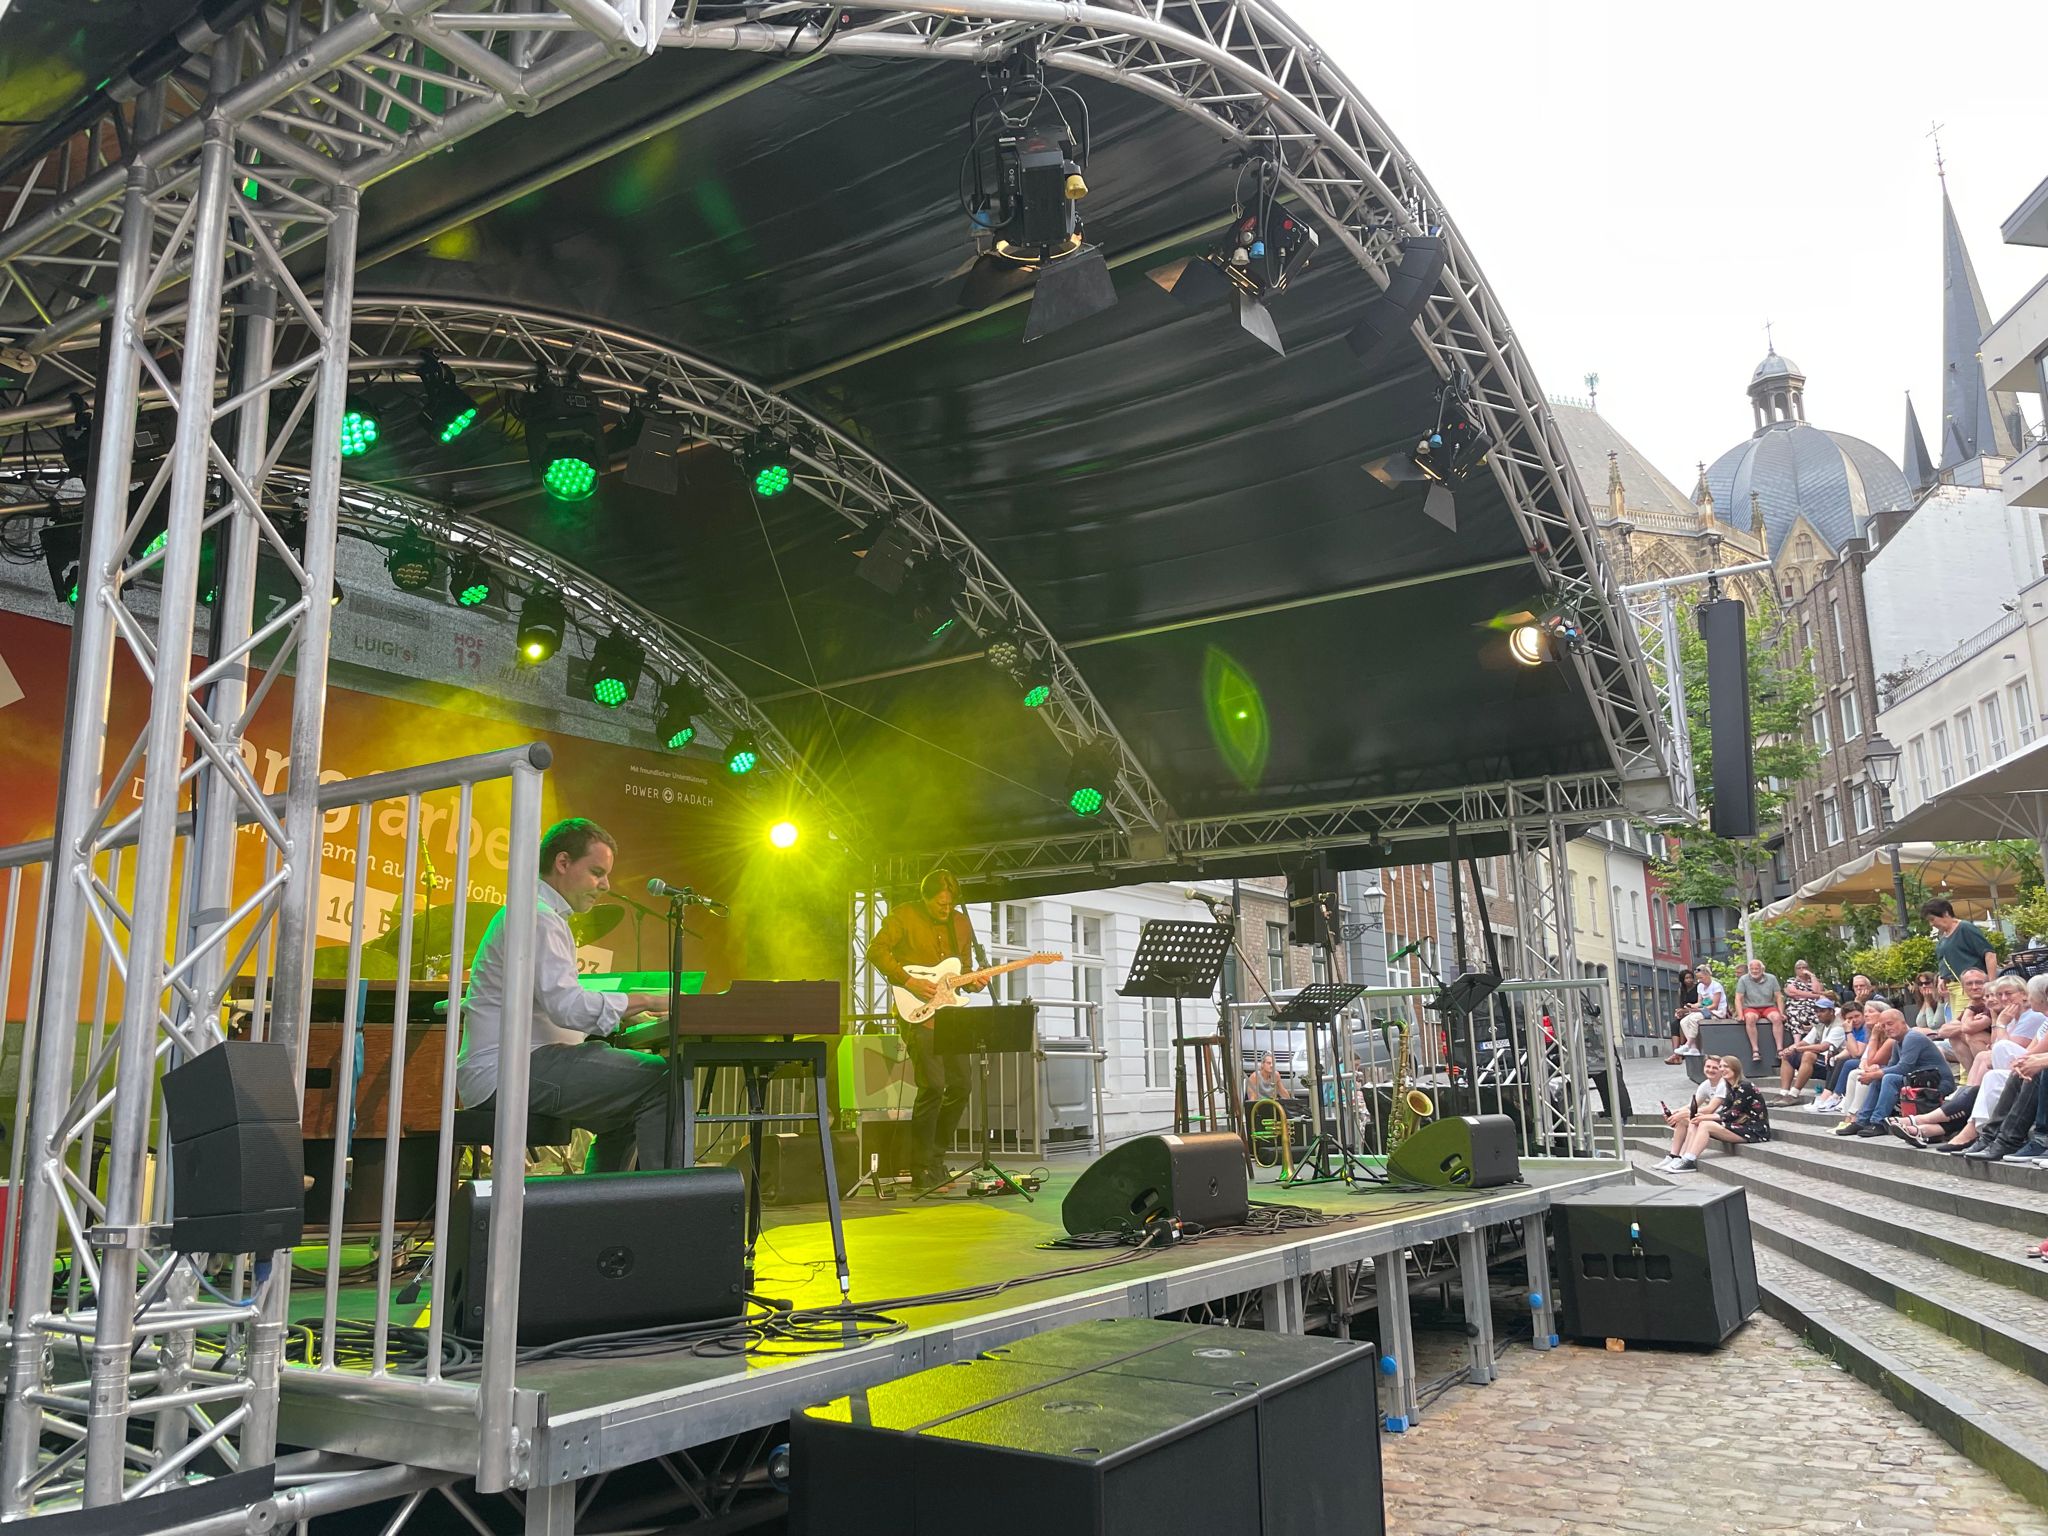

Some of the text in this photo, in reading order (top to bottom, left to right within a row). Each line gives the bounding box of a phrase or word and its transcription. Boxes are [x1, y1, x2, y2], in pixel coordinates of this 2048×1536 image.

[453, 632, 484, 649] HOF
[630, 765, 639, 773] Mit
[625, 783, 713, 807] POWER RADACH
